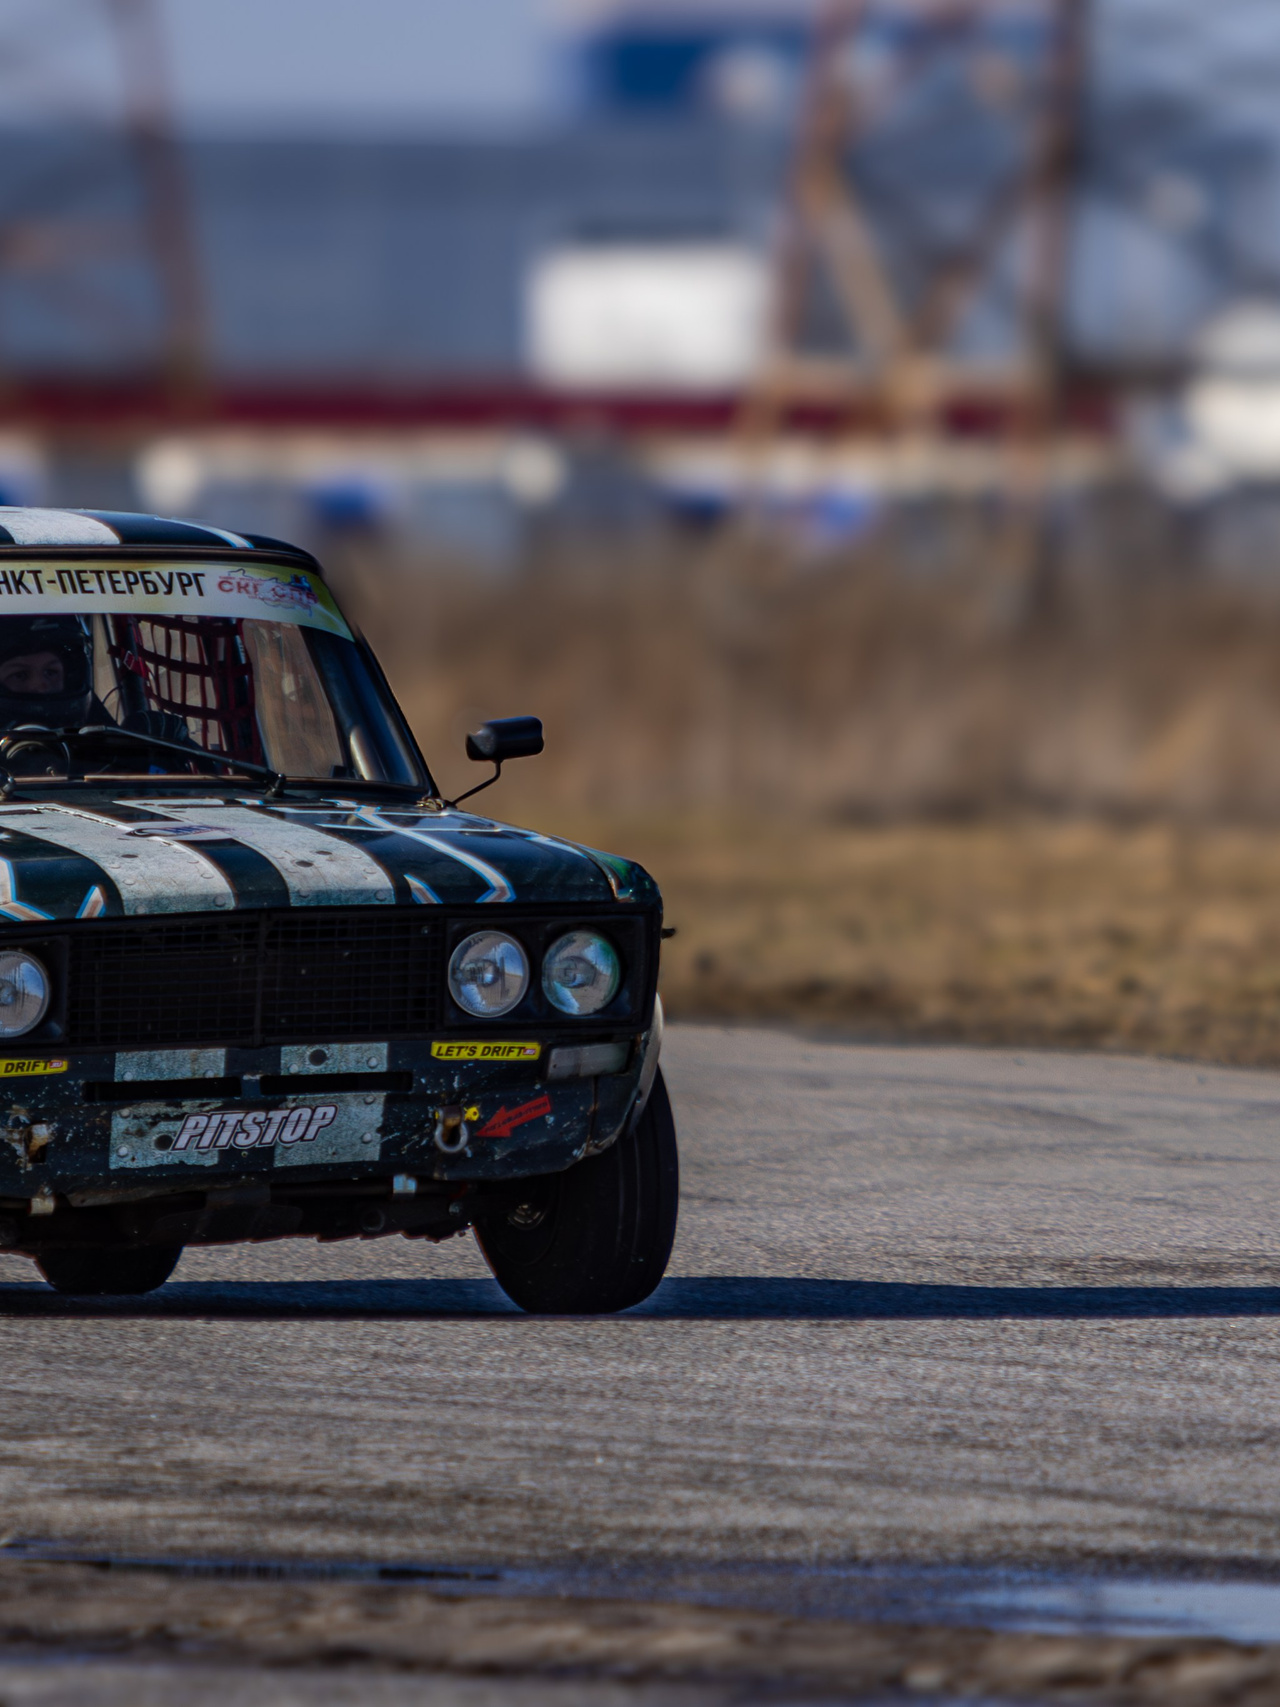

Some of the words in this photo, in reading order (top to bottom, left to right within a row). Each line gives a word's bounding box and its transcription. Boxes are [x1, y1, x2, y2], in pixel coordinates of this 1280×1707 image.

[435, 1045, 478, 1057] LET'S
[481, 1045, 526, 1057] DRIFT
[3, 1060, 51, 1074] DRIFT
[171, 1104, 339, 1151] PITSTOP
